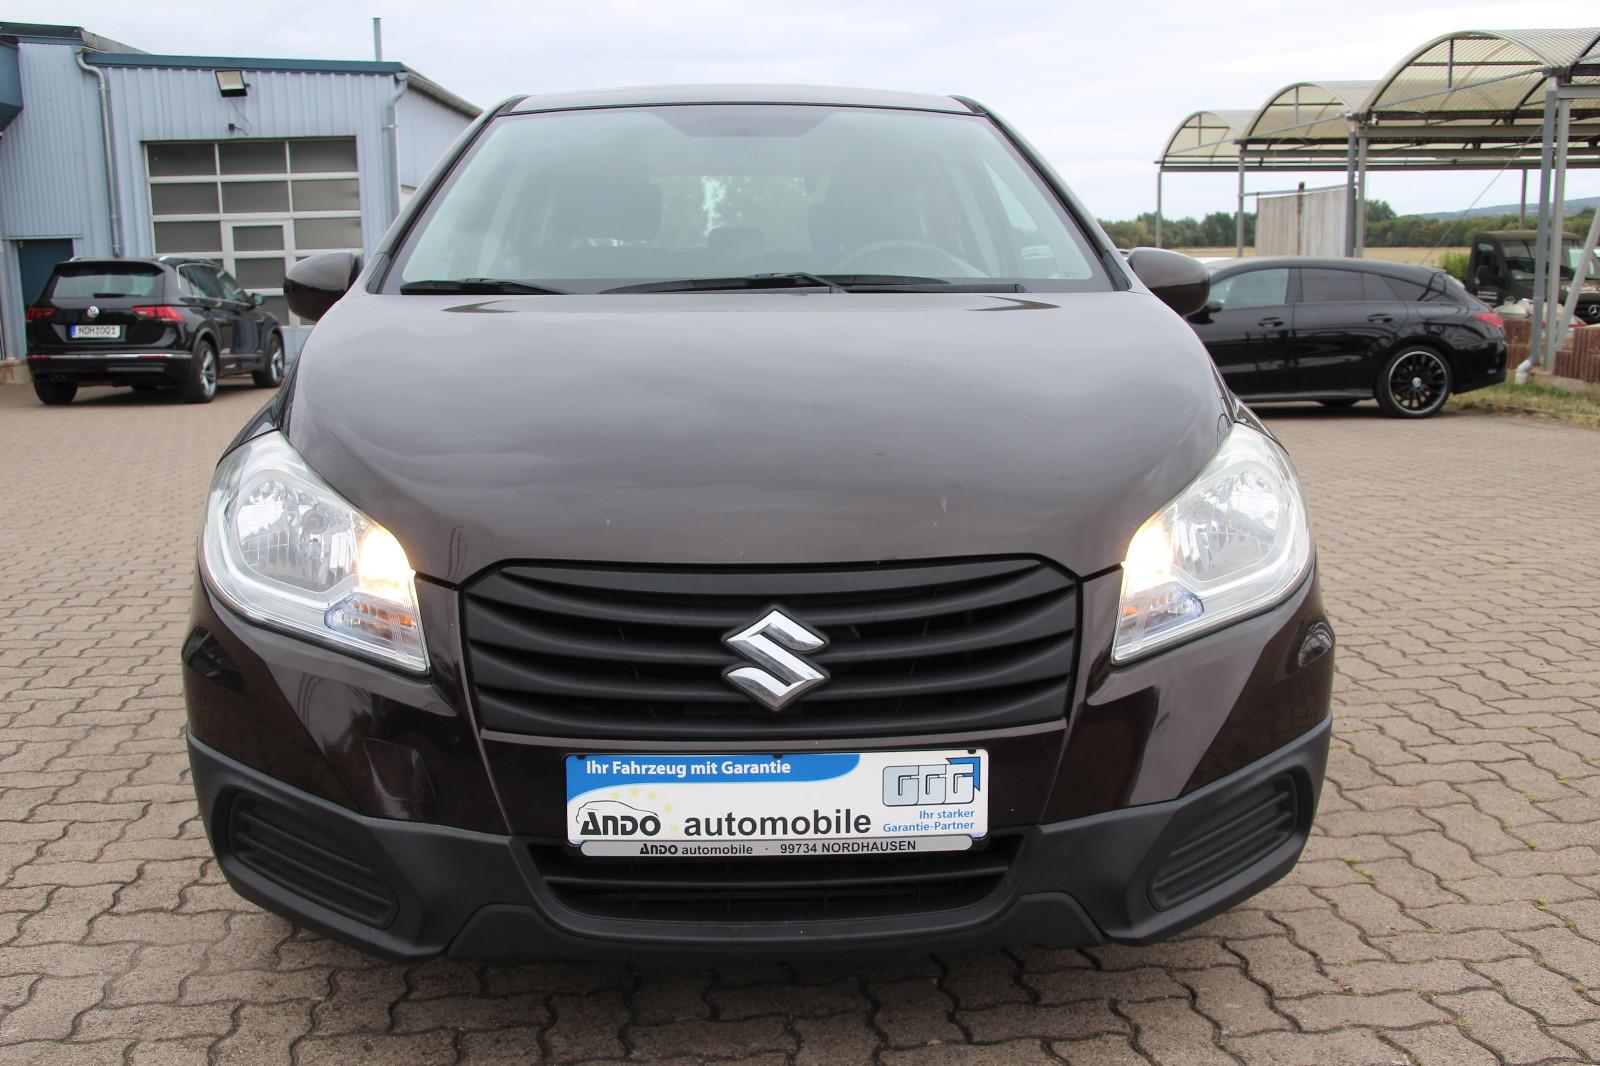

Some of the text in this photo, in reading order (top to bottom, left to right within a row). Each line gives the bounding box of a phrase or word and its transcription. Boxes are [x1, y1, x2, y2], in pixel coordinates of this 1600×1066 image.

[586, 760, 791, 777] Ihr Fahrzeug mit Garantie
[919, 808, 975, 819] Ihr starker
[684, 808, 872, 837] automobile
[882, 821, 975, 833] Garantie-Partner
[681, 843, 753, 855] automobile
[780, 843, 817, 854] 99734
[821, 840, 917, 853] NORDHAUSEN
